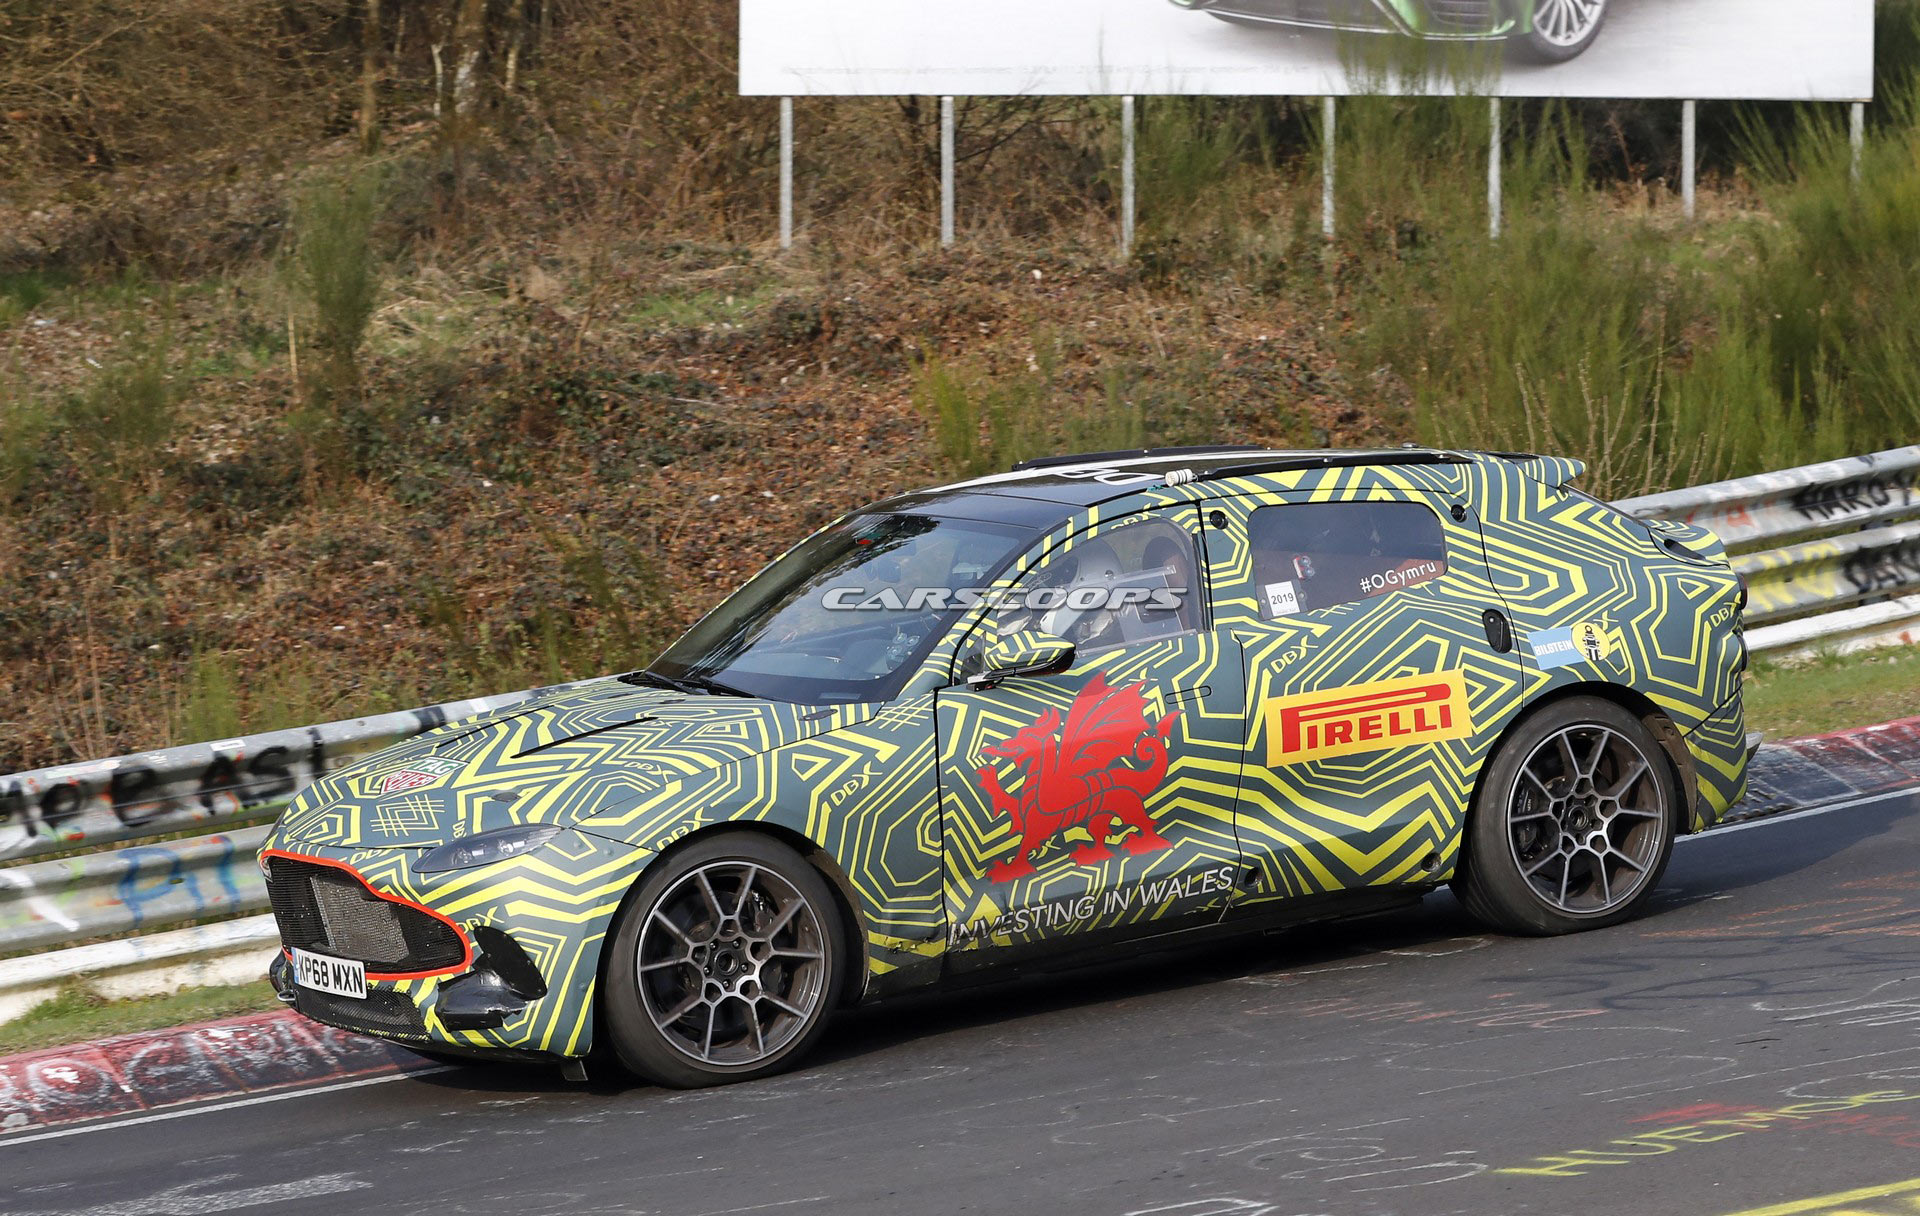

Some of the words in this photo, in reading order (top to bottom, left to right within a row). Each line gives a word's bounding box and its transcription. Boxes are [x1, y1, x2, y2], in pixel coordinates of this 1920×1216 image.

[1359, 561, 1437, 593] #OGymru
[1271, 593, 1294, 605] 2019
[1271, 635, 1319, 674] DBX
[1280, 683, 1453, 753] PIRELLI
[413, 758, 459, 774] TAG
[624, 761, 677, 784] DBX
[831, 760, 883, 806] DBX
[656, 807, 714, 851] DBX
[948, 896, 1096, 946] INVESTING
[1103, 889, 1140, 915] IN
[1139, 866, 1233, 906] WALES
[297, 953, 330, 988] KP68
[332, 962, 363, 993] MXN
